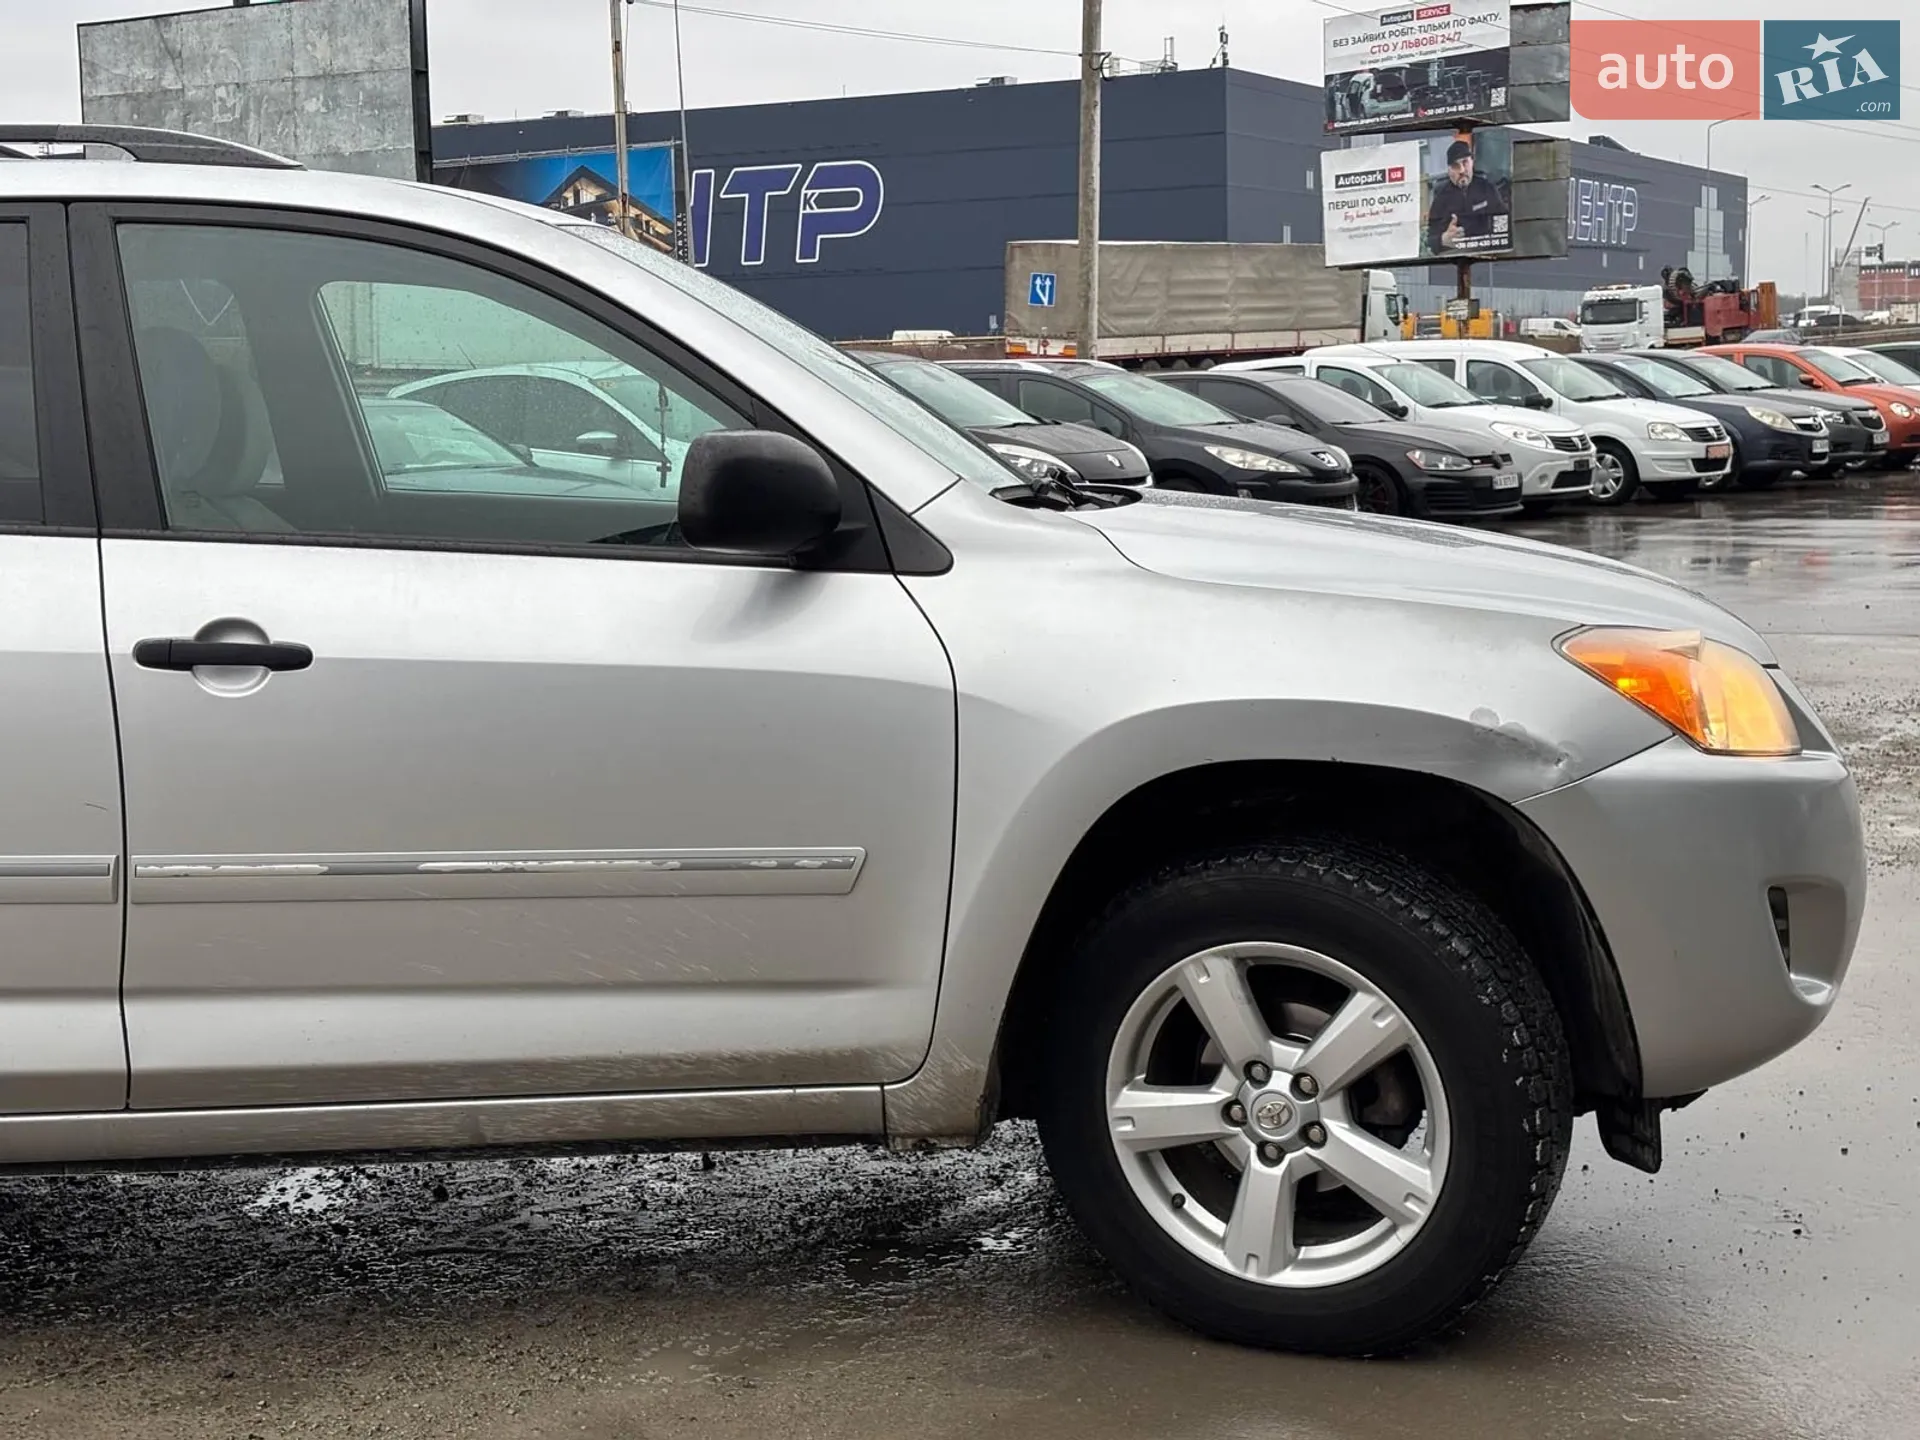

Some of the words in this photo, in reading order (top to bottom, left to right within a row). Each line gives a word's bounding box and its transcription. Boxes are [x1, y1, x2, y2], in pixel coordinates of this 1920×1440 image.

[1382, 12, 1413, 24] Autopark
[1418, 6, 1449, 18] SERVICE
[1333, 38, 1349, 48] БЕЗ
[1351, 32, 1387, 46] ЗАЙВИХ
[1388, 27, 1416, 39] РОБІТ.
[1418, 21, 1451, 34] ТІЛЬКИ
[1452, 18, 1467, 29] ПО
[1468, 12, 1502, 25] ФАКТУ.
[1370, 43, 1390, 55] СТО
[1392, 42, 1399, 53] У
[1400, 34, 1438, 50] ЛЬВОВІ
[1440, 31, 1462, 44] 24/7
[1338, 171, 1383, 186] Autopark
[1328, 199, 1359, 211] ПЕРШІ
[1361, 197, 1376, 207] ПО
[1377, 193, 1413, 206] ФАКТУ.
